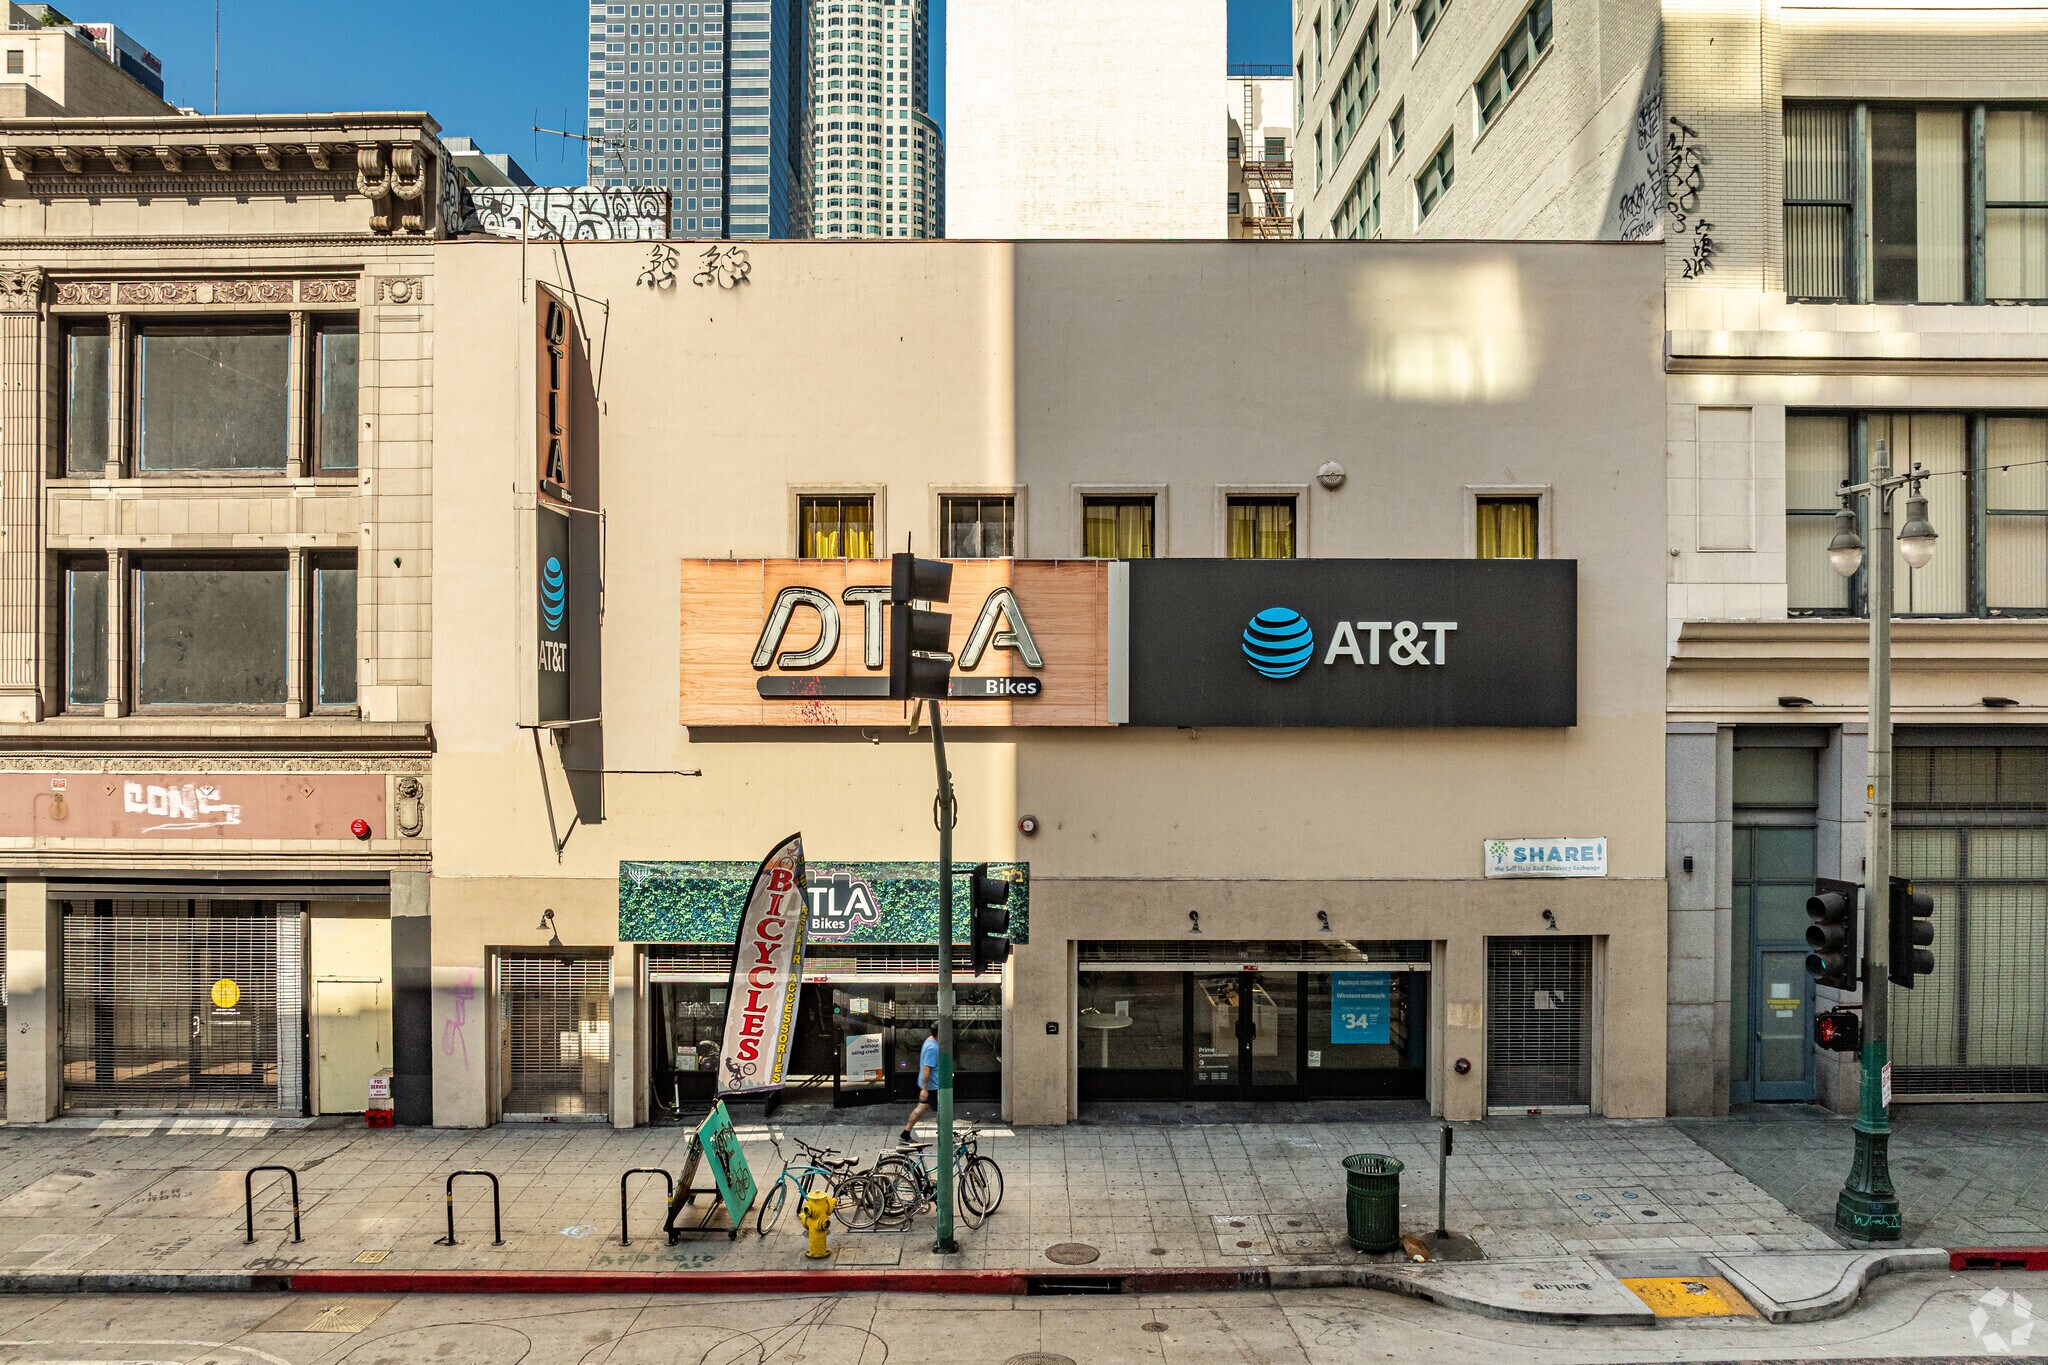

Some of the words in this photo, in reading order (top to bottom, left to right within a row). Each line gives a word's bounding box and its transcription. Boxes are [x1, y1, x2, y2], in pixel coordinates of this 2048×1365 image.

[751, 585, 1044, 670] DTA
[1324, 620, 1458, 665] AT&T
[538, 640, 567, 672] AT&T
[985, 678, 1037, 695] Bikes
[812, 918, 845, 929] Bikes
[737, 868, 793, 1061] BICYCLES
[772, 973, 798, 1083] ACCESSORIES
[1341, 1013, 1368, 1029] $34
